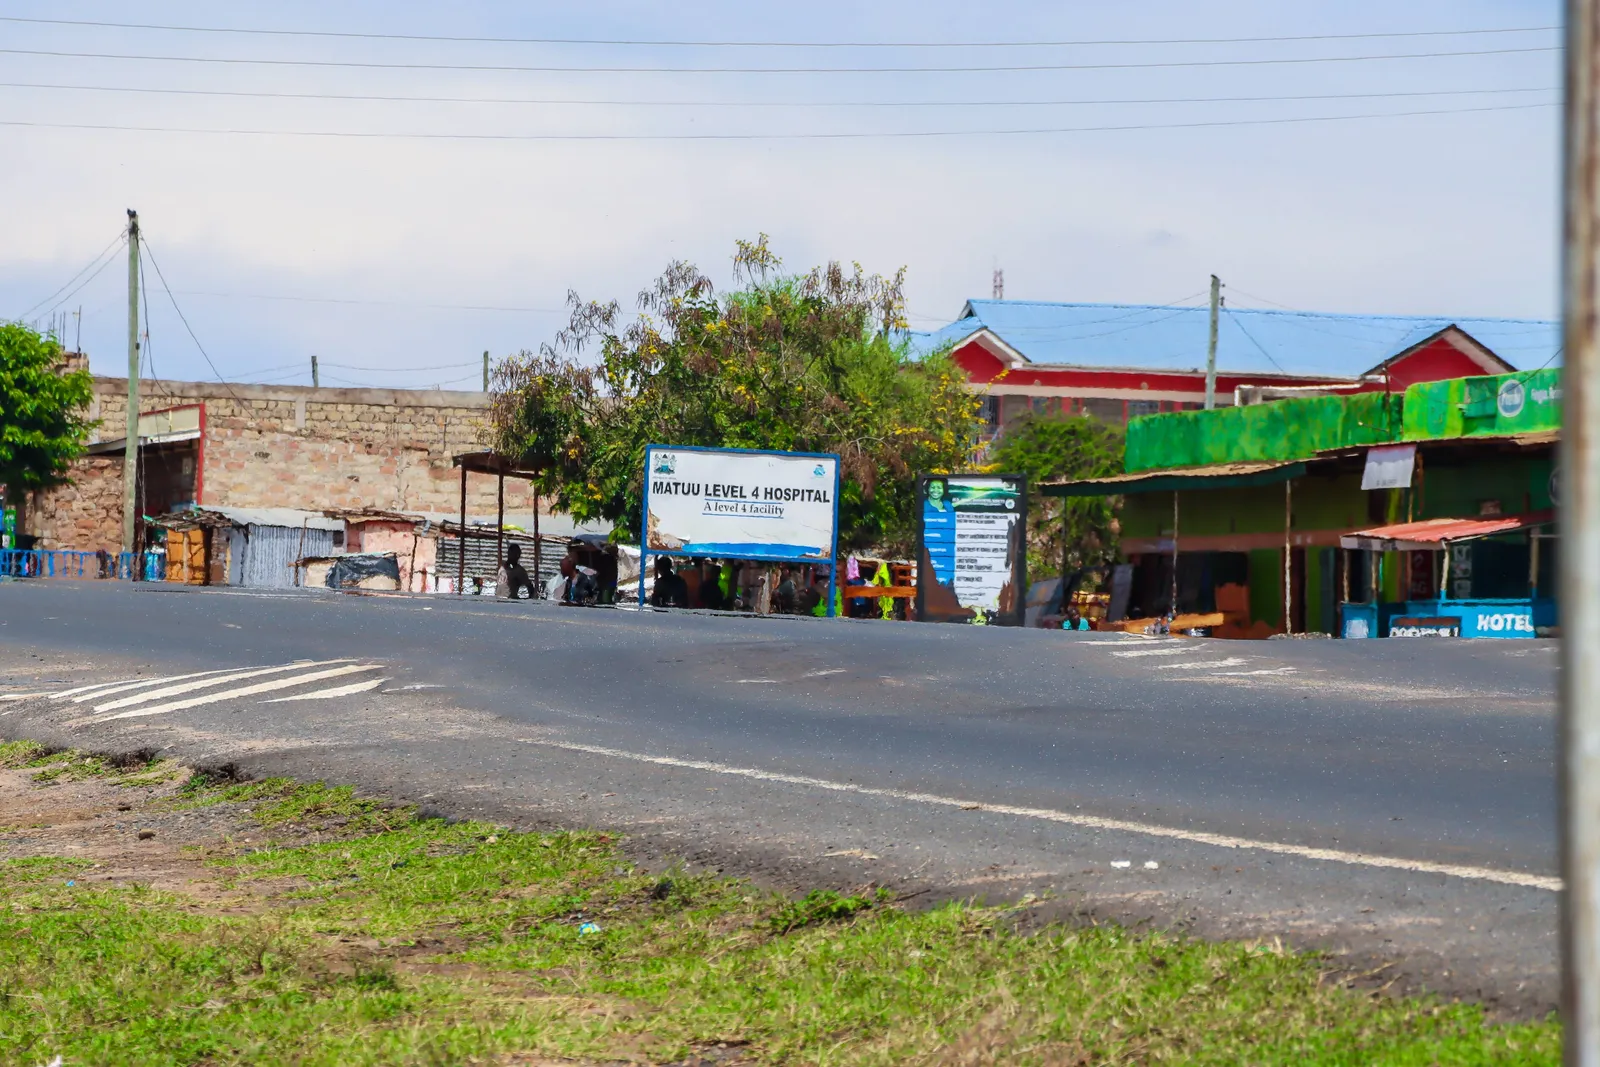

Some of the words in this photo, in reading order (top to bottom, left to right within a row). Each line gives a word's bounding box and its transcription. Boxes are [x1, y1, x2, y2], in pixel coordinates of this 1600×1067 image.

[652, 481, 700, 497] MATUU
[704, 484, 747, 499] LEVEL
[751, 486, 760, 499] 4
[764, 487, 830, 503] HOSPITAL
[704, 502, 712, 511] A
[714, 502, 739, 513] level
[741, 504, 747, 513] 4
[749, 503, 785, 518] facility
[1477, 613, 1534, 632] HOTEL
